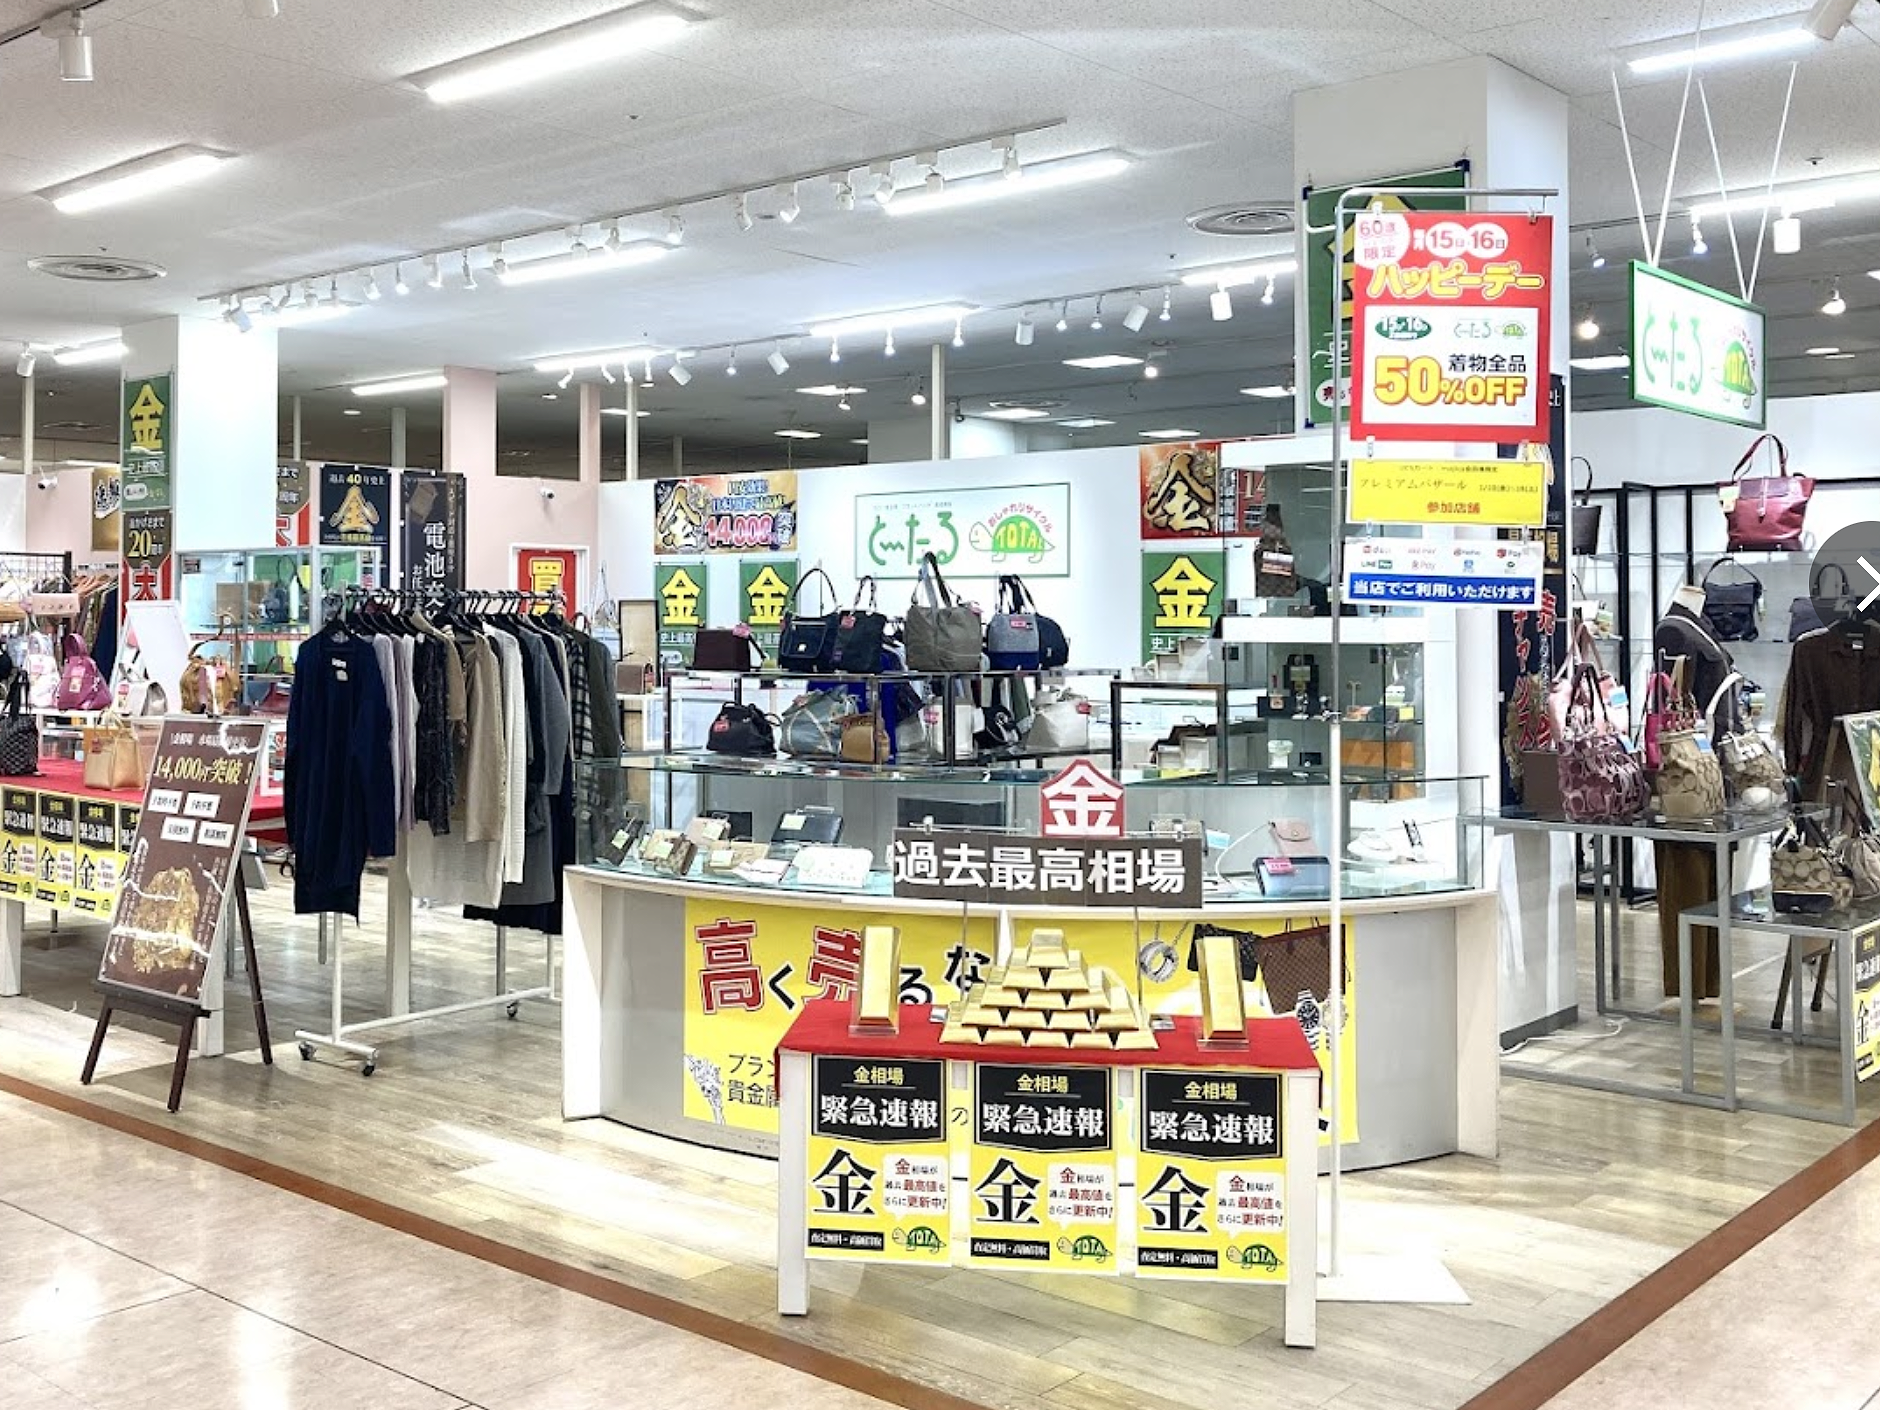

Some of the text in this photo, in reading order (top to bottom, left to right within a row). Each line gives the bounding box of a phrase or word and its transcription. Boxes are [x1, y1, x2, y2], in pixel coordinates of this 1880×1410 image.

[1363, 246, 1396, 260] 限定
[1366, 259, 1545, 300] ハッピーデー
[1374, 355, 1528, 406] 50%OFF
[1448, 353, 1527, 373] 着物全品
[129, 384, 165, 449] 金
[1144, 452, 1215, 532] 金
[1427, 502, 1481, 515] 参加店舗
[988, 502, 1053, 533] おしゃれリサイクル
[996, 521, 1044, 549] TOTAL
[661, 568, 702, 625] 金
[747, 565, 790, 624] 金
[1150, 556, 1217, 628] 金
[1353, 580, 1534, 600] 当店でご利用いただけます
[1042, 763, 1125, 835] 金
[1, 839, 18, 874] 金
[40, 846, 56, 883] 金
[78, 853, 95, 891] 金
[894, 840, 1187, 894] 過去最高相場
[1856, 999, 1870, 1047] 金
[853, 1065, 904, 1085] 金相場
[1016, 1073, 1069, 1094] 金相場
[1184, 1081, 1238, 1100] 金相場
[820, 1094, 938, 1129] 緊急速報
[951, 1107, 968, 1126] の
[982, 1103, 1105, 1138] 緊急速報
[1149, 1110, 1275, 1145] 緊急速報
[813, 1148, 878, 1215] 金
[974, 1157, 1041, 1225] 金
[1141, 1165, 1211, 1233] 金
